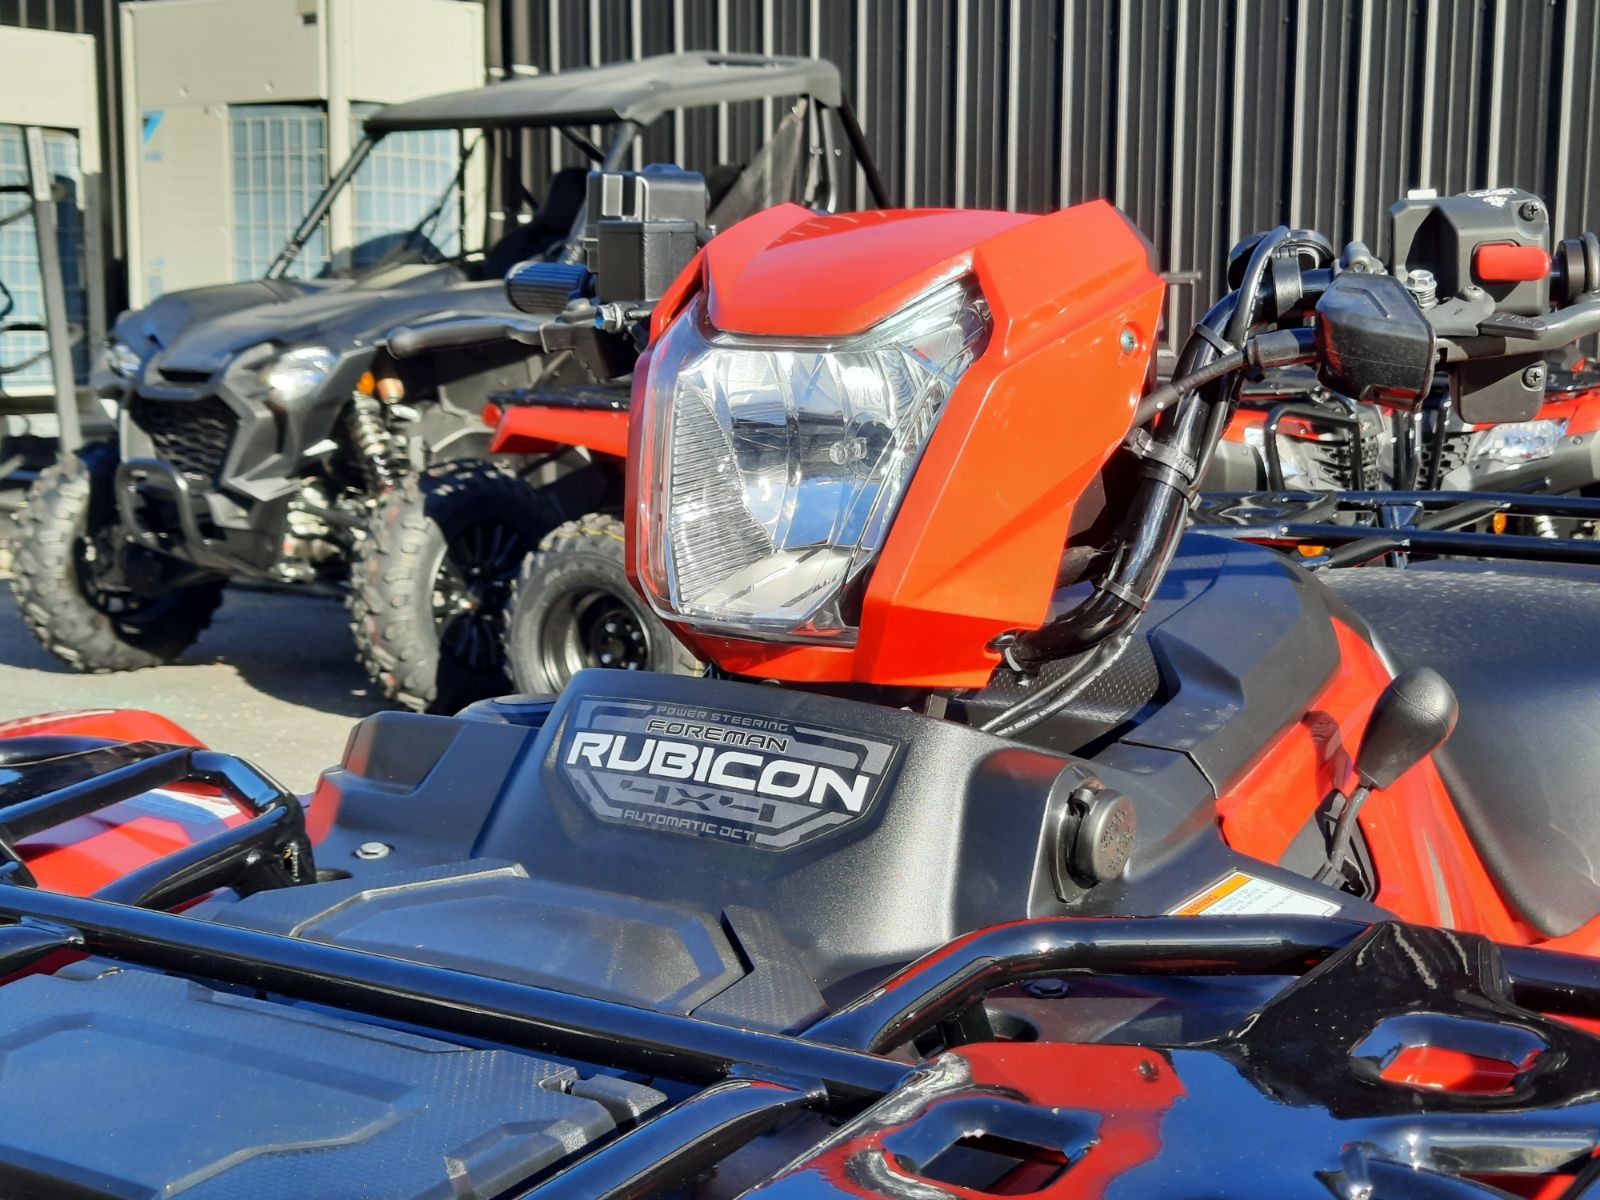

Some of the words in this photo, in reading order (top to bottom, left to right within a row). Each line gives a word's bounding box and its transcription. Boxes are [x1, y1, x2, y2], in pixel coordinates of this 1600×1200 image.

[656, 705, 707, 719] POWER
[711, 711, 790, 732] STEERING
[646, 719, 788, 753] FOREMAN
[566, 732, 871, 813] RUBICON
[624, 810, 718, 835] AUTOMATIC
[720, 825, 755, 842] DCT
